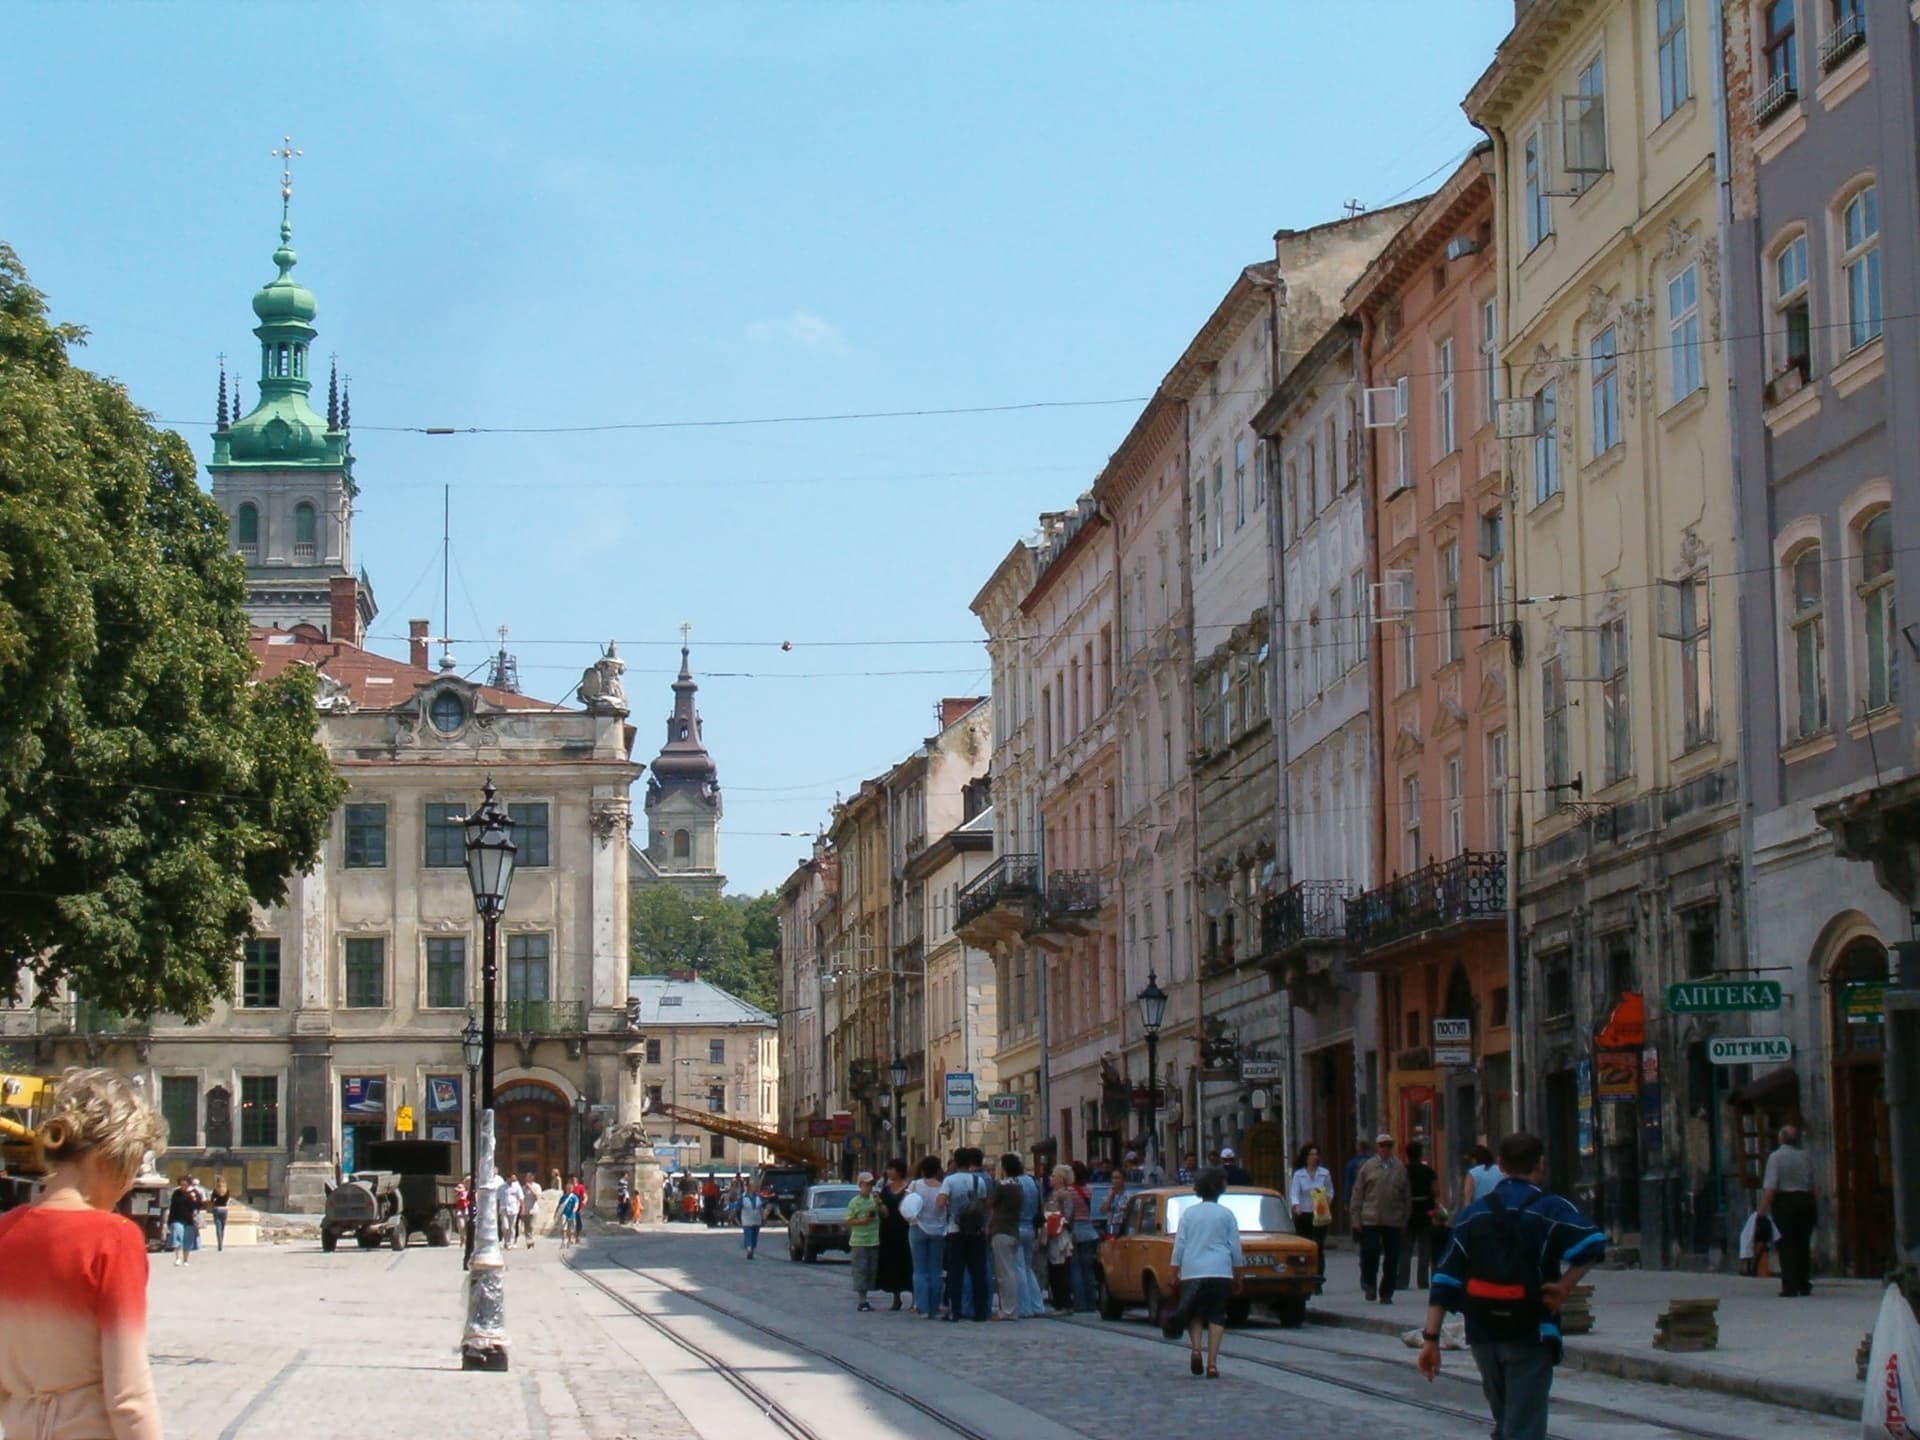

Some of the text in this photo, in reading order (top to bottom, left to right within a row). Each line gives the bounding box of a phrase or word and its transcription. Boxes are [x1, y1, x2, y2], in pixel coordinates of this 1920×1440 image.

[1674, 985, 1776, 1006] АПТЕКА
[1713, 1040, 1789, 1057] ОПТИКА
[994, 1099, 1016, 1108] БАР
